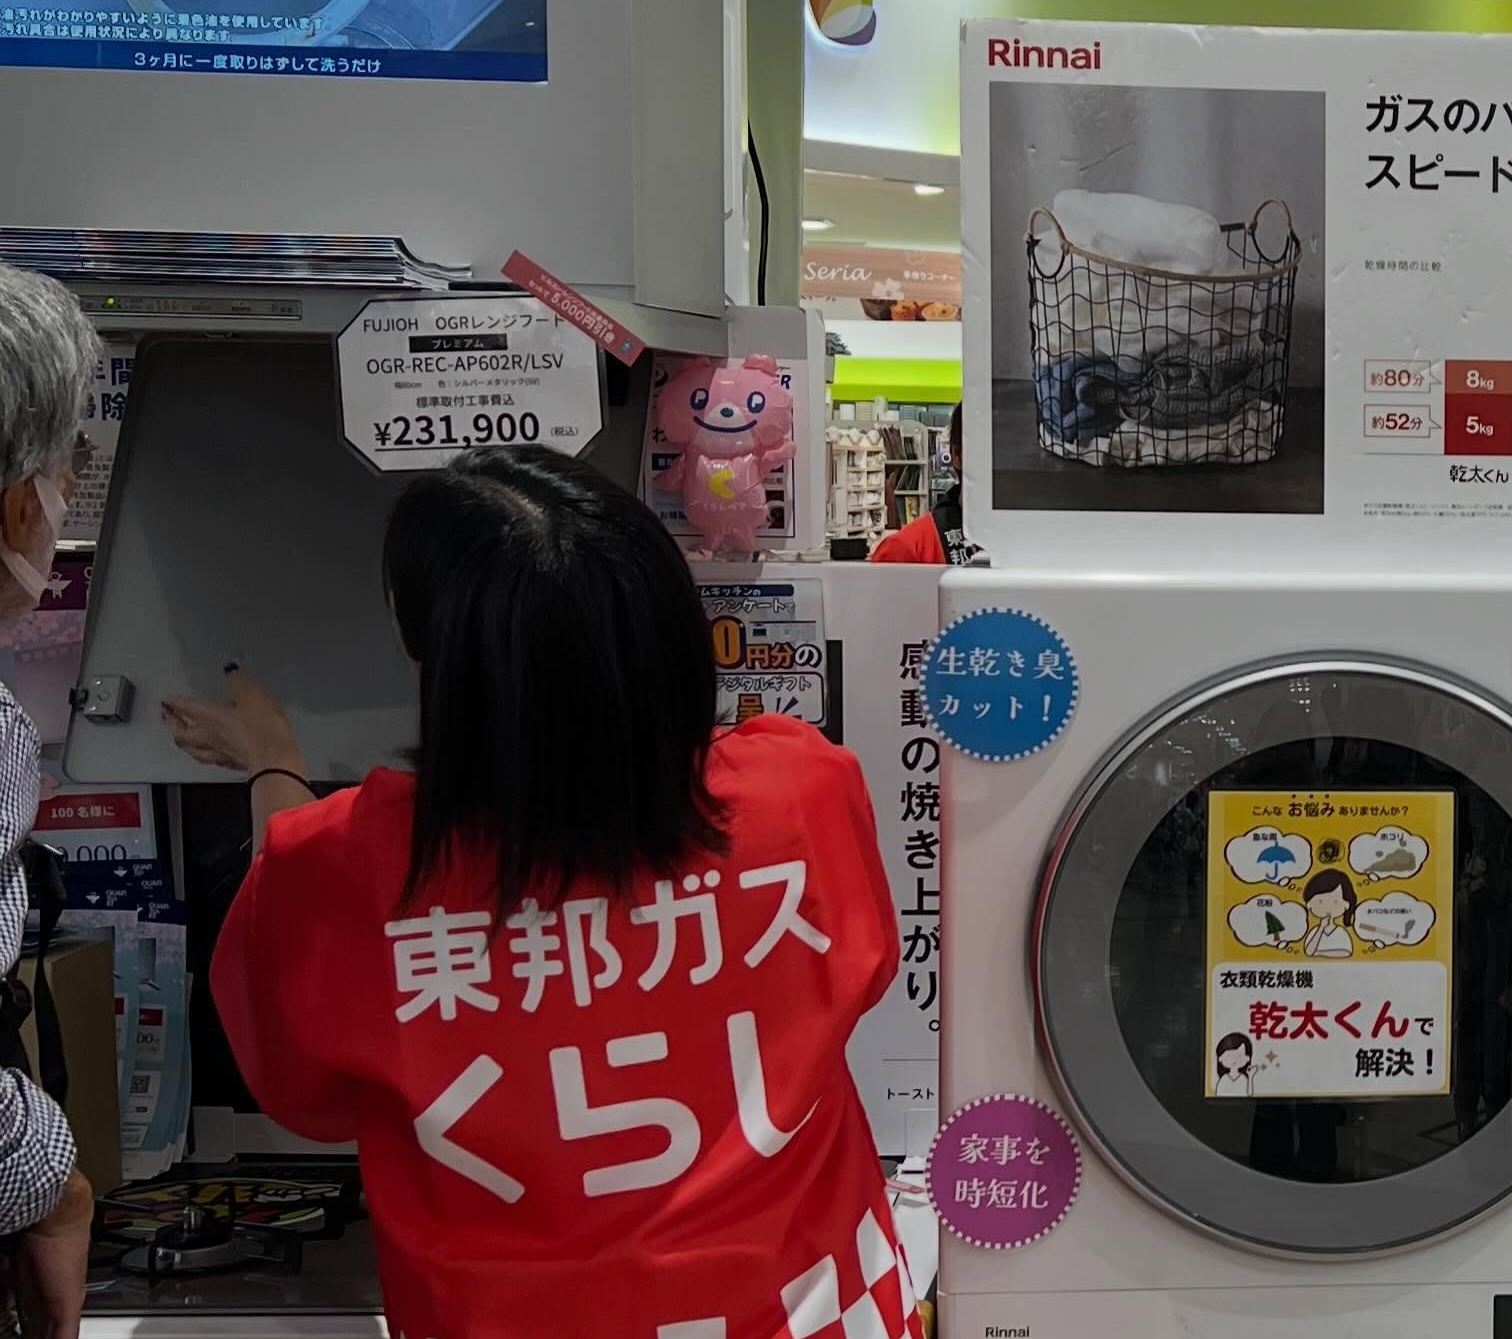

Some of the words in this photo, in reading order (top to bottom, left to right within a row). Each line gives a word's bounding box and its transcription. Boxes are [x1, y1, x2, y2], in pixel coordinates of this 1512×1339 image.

[988, 38, 1102, 71] Rinnai
[804, 261, 872, 281] Seria
[363, 317, 419, 333] FUJIOH
[431, 338, 485, 350] プレミアム
[367, 353, 564, 375] OGR-REC-AP602R/LSV
[1370, 368, 1425, 387] 約80分
[1466, 370, 1495, 390] 8kg
[416, 393, 515, 409] 標準取付工事費込
[374, 412, 540, 448] ¥231,900
[1371, 413, 1423, 431] 約52分
[1465, 416, 1494, 436] 5kg
[1449, 464, 1510, 484] 乾太くん
[936, 645, 1065, 681] 生乾き臭
[938, 693, 1051, 722] カット！
[50, 807, 74, 819] 100
[1252, 805, 1283, 816] こんな
[1288, 801, 1336, 818] お悩み
[384, 859, 832, 1024] 東邦ガス
[1220, 970, 1314, 989] 衣類乾燥機
[1249, 1000, 1435, 1040] 乾太くんで
[1355, 1047, 1434, 1078] 解決！
[885, 1087, 935, 1100] トースト
[413, 1010, 823, 1205] くらし
[958, 1133, 1050, 1166] 家事を
[955, 1177, 1049, 1209] 時短化
[985, 1326, 1030, 1339] Rinnai
